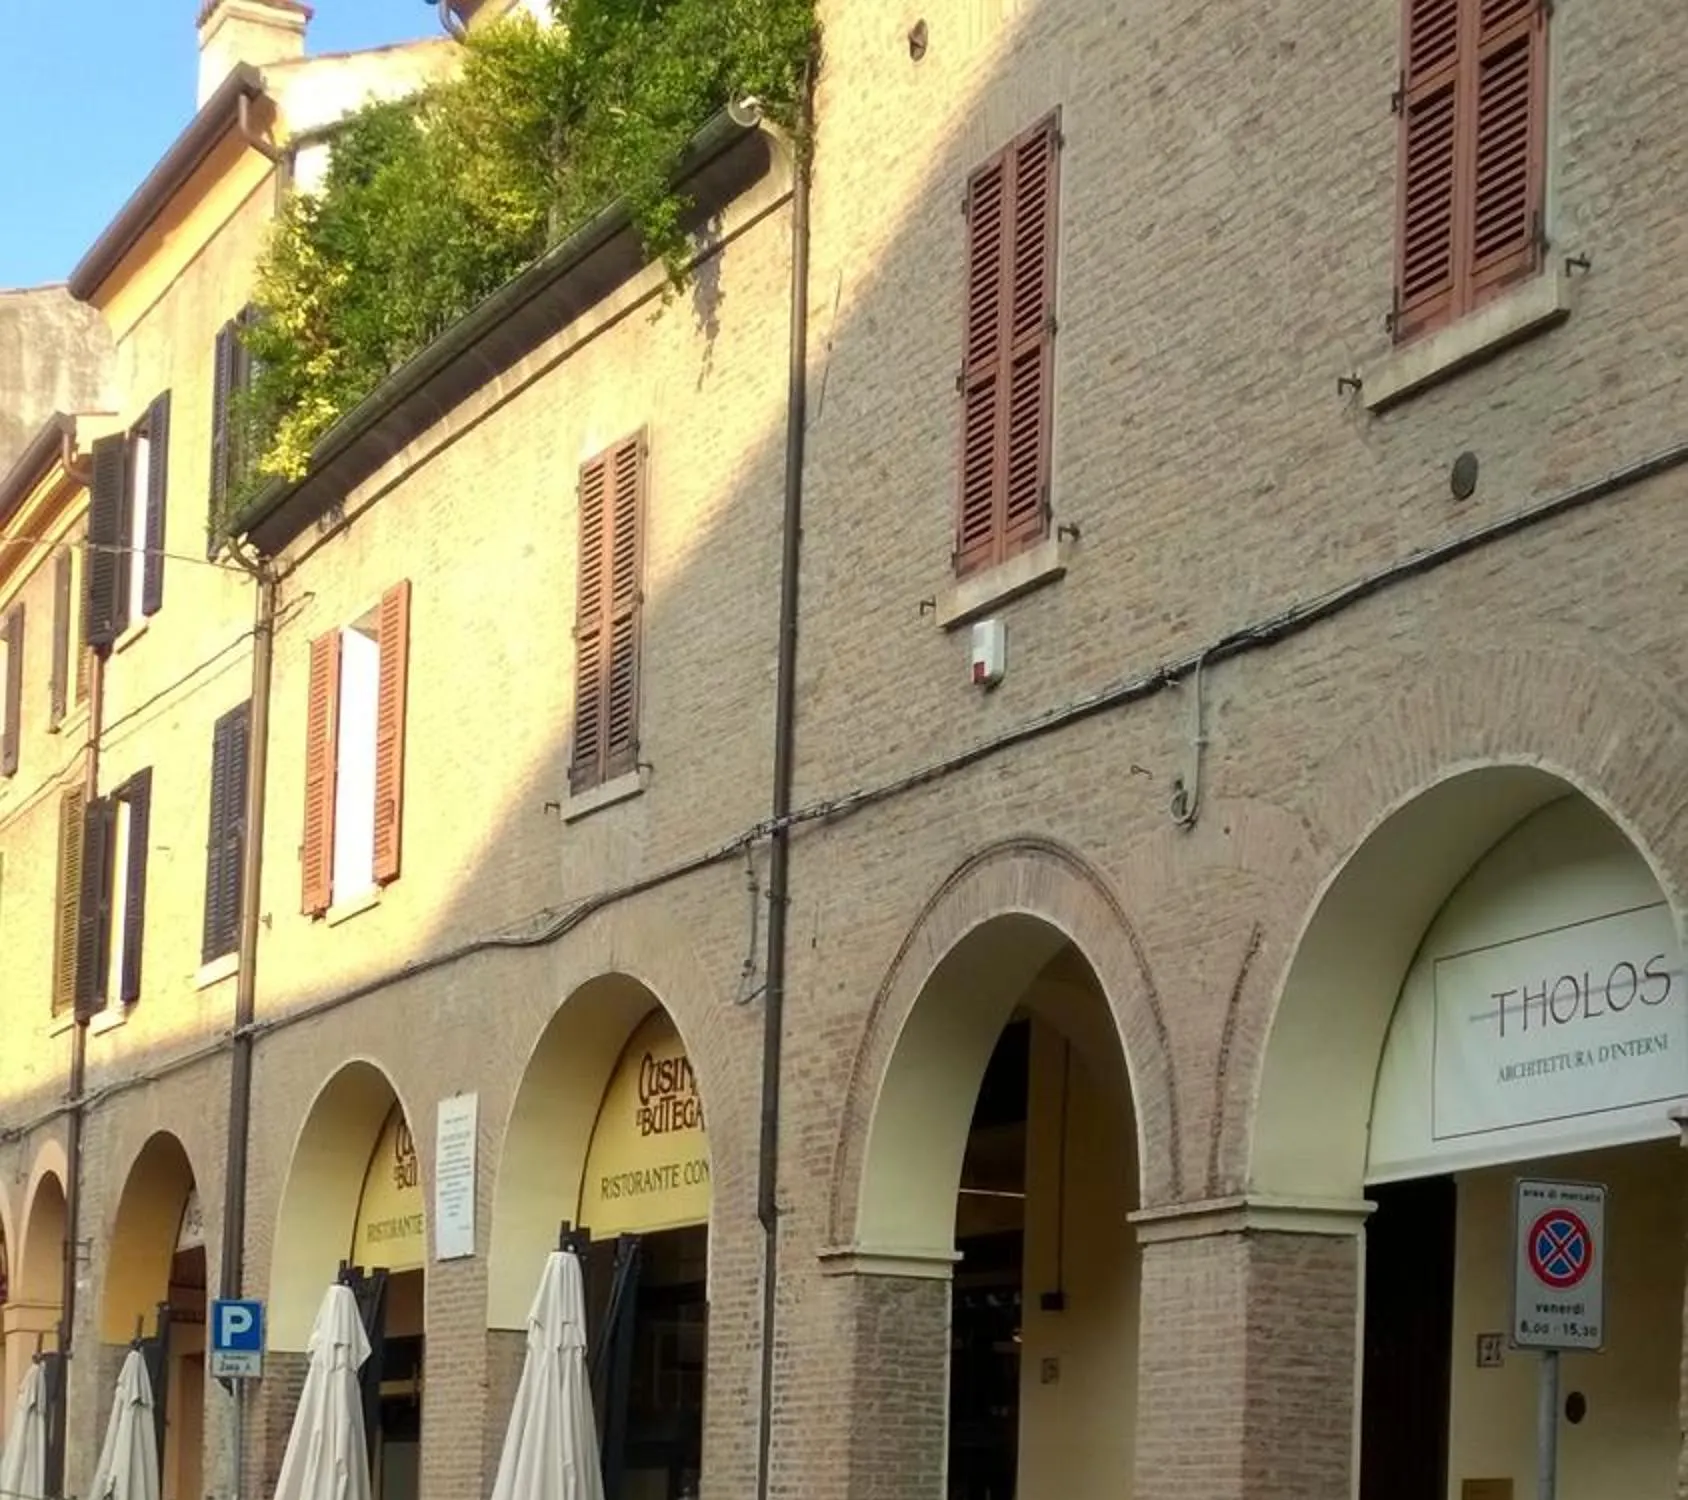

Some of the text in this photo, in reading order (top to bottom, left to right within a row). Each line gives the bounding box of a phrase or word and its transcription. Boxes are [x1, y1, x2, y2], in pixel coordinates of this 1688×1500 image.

[1491, 954, 1671, 1038] THOLOS
[1498, 1050, 1594, 1084] ARCHITETTURA
[601, 1163, 680, 1201] RISTORANTE
[221, 1306, 252, 1346] P
